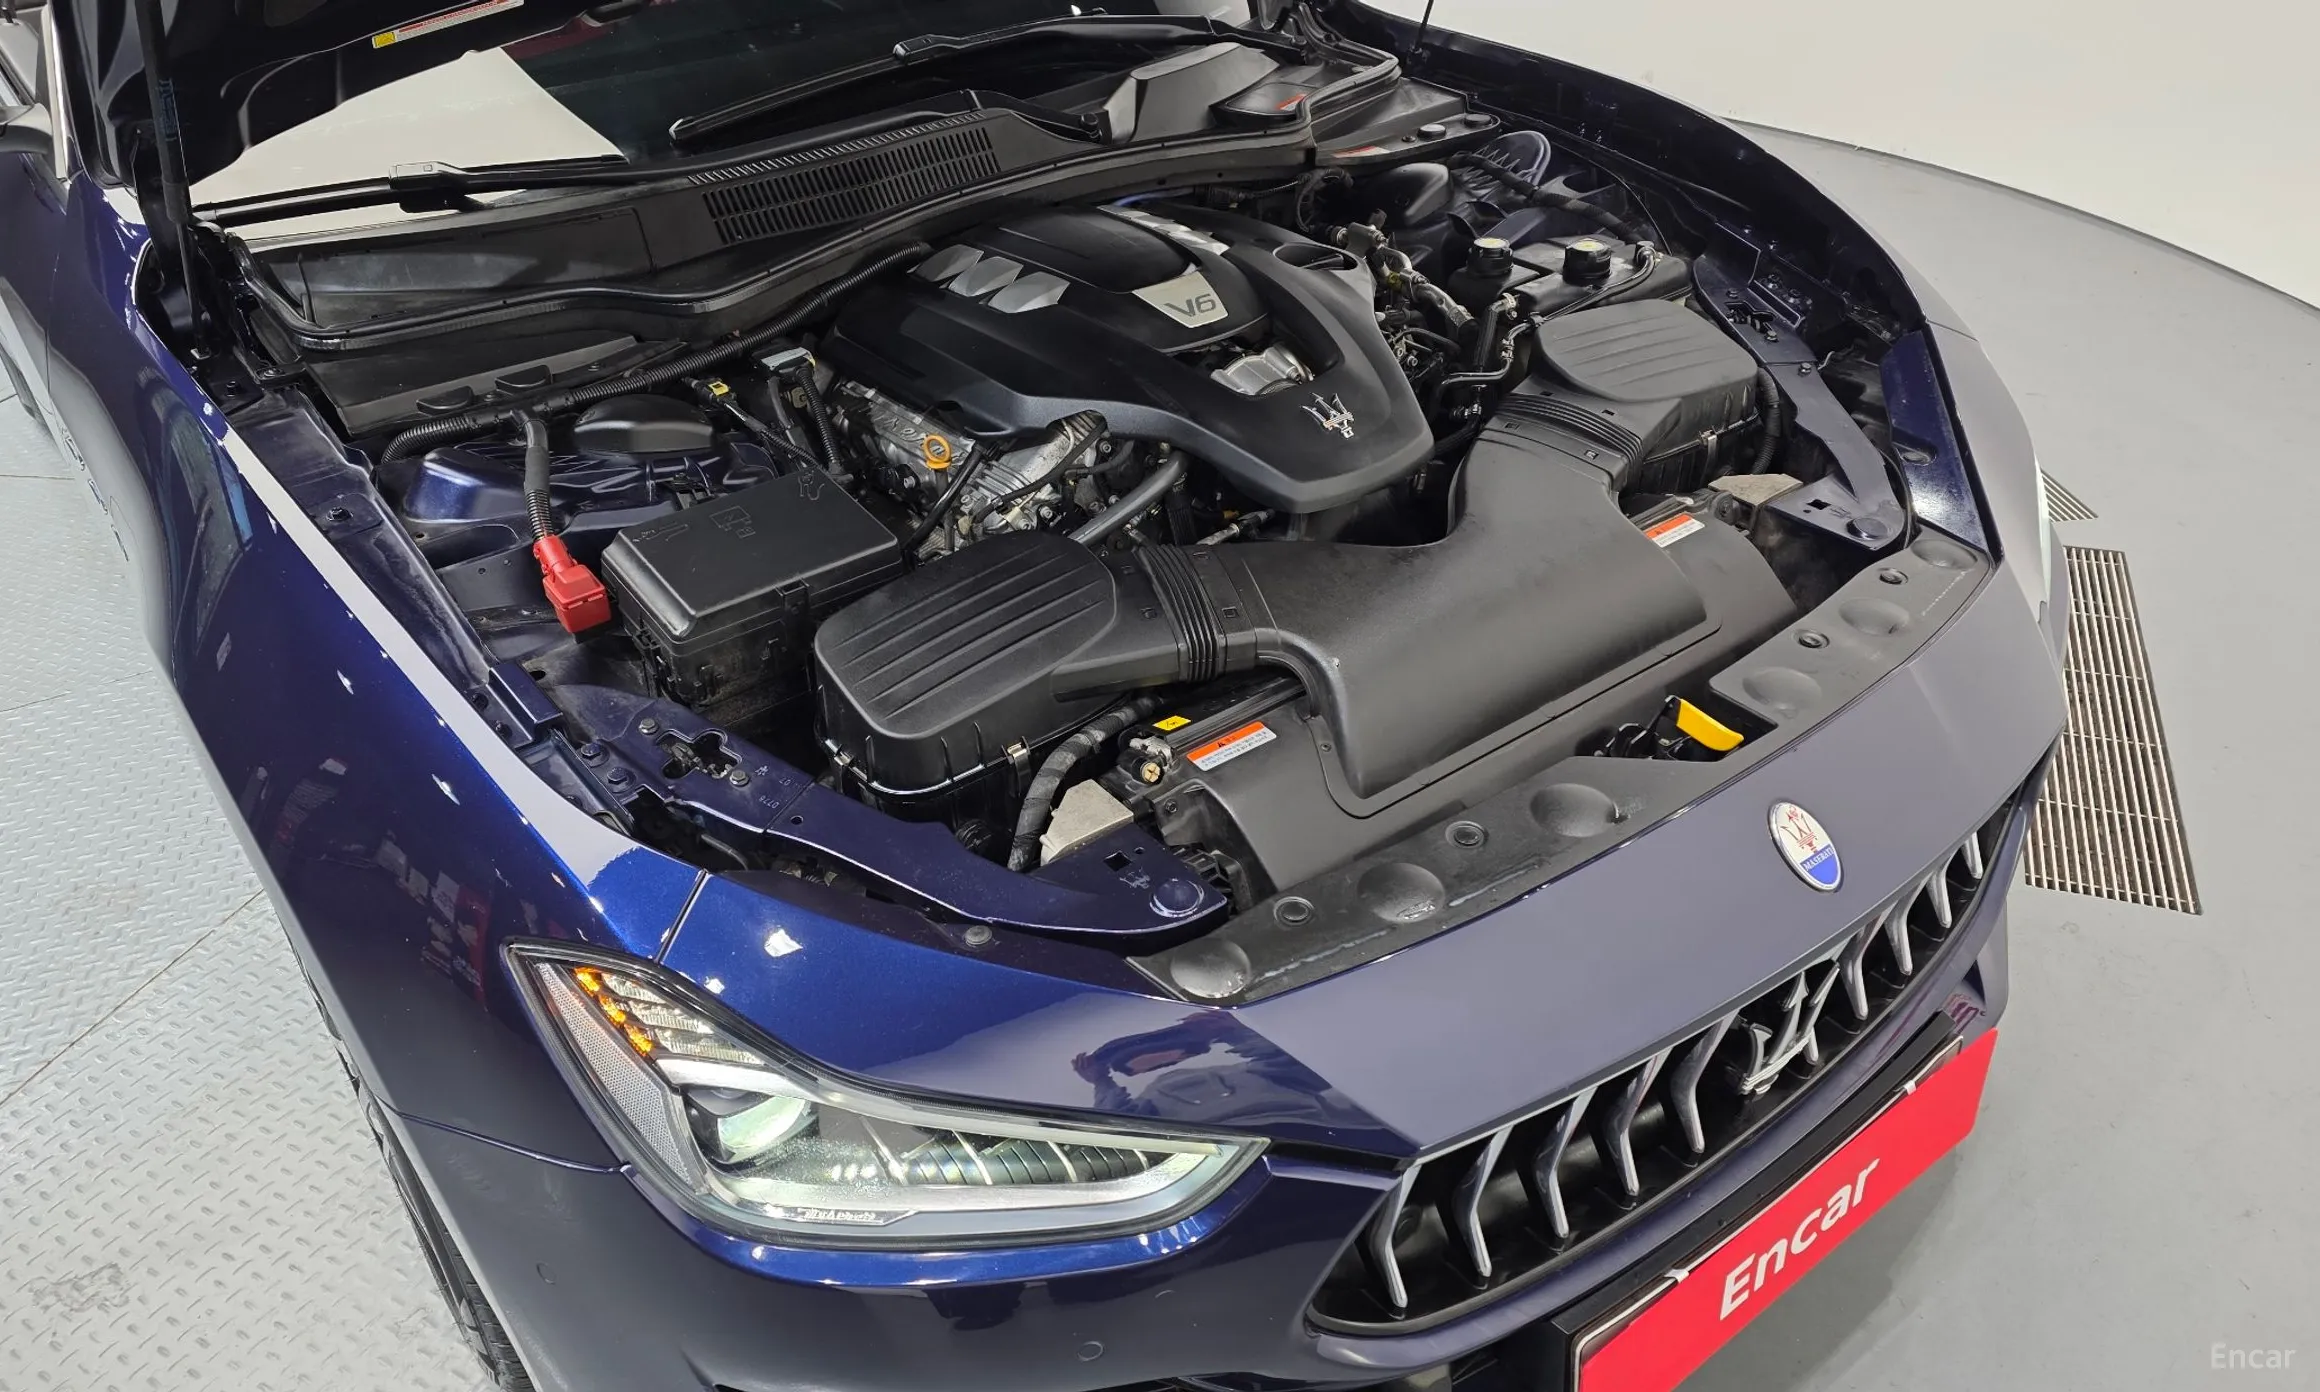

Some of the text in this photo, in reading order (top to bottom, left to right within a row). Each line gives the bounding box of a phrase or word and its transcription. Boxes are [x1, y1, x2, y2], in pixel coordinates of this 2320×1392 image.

[1163, 293, 1216, 317] V6
[1803, 847, 1835, 871] MASERATI
[1720, 1158, 1880, 1321] Encar
